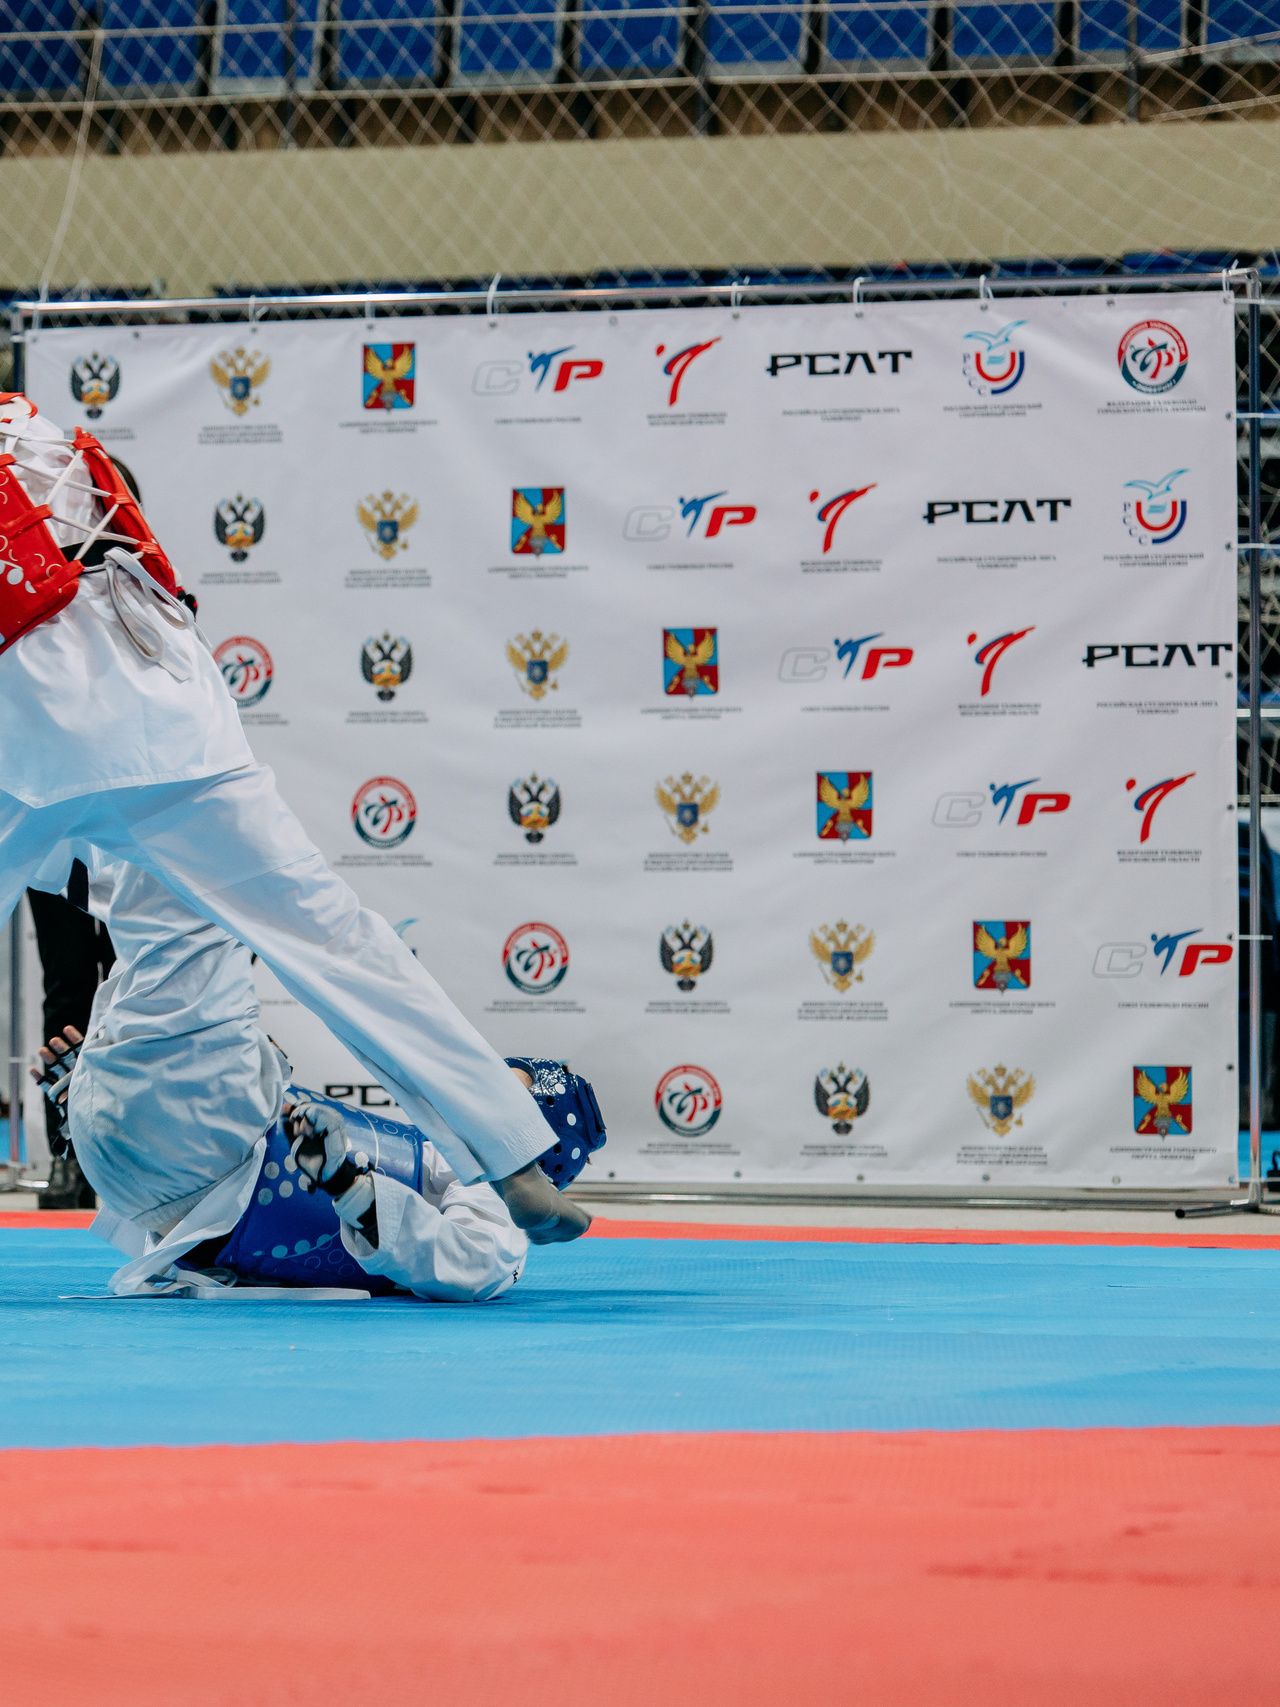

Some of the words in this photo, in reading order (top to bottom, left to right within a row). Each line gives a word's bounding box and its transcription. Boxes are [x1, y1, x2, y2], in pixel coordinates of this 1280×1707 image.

[766, 350, 913, 377] РСЛТ
[922, 498, 1072, 525] РСЛТ
[1081, 643, 1233, 668] РСЛТ
[325, 1084, 400, 1108] РС
